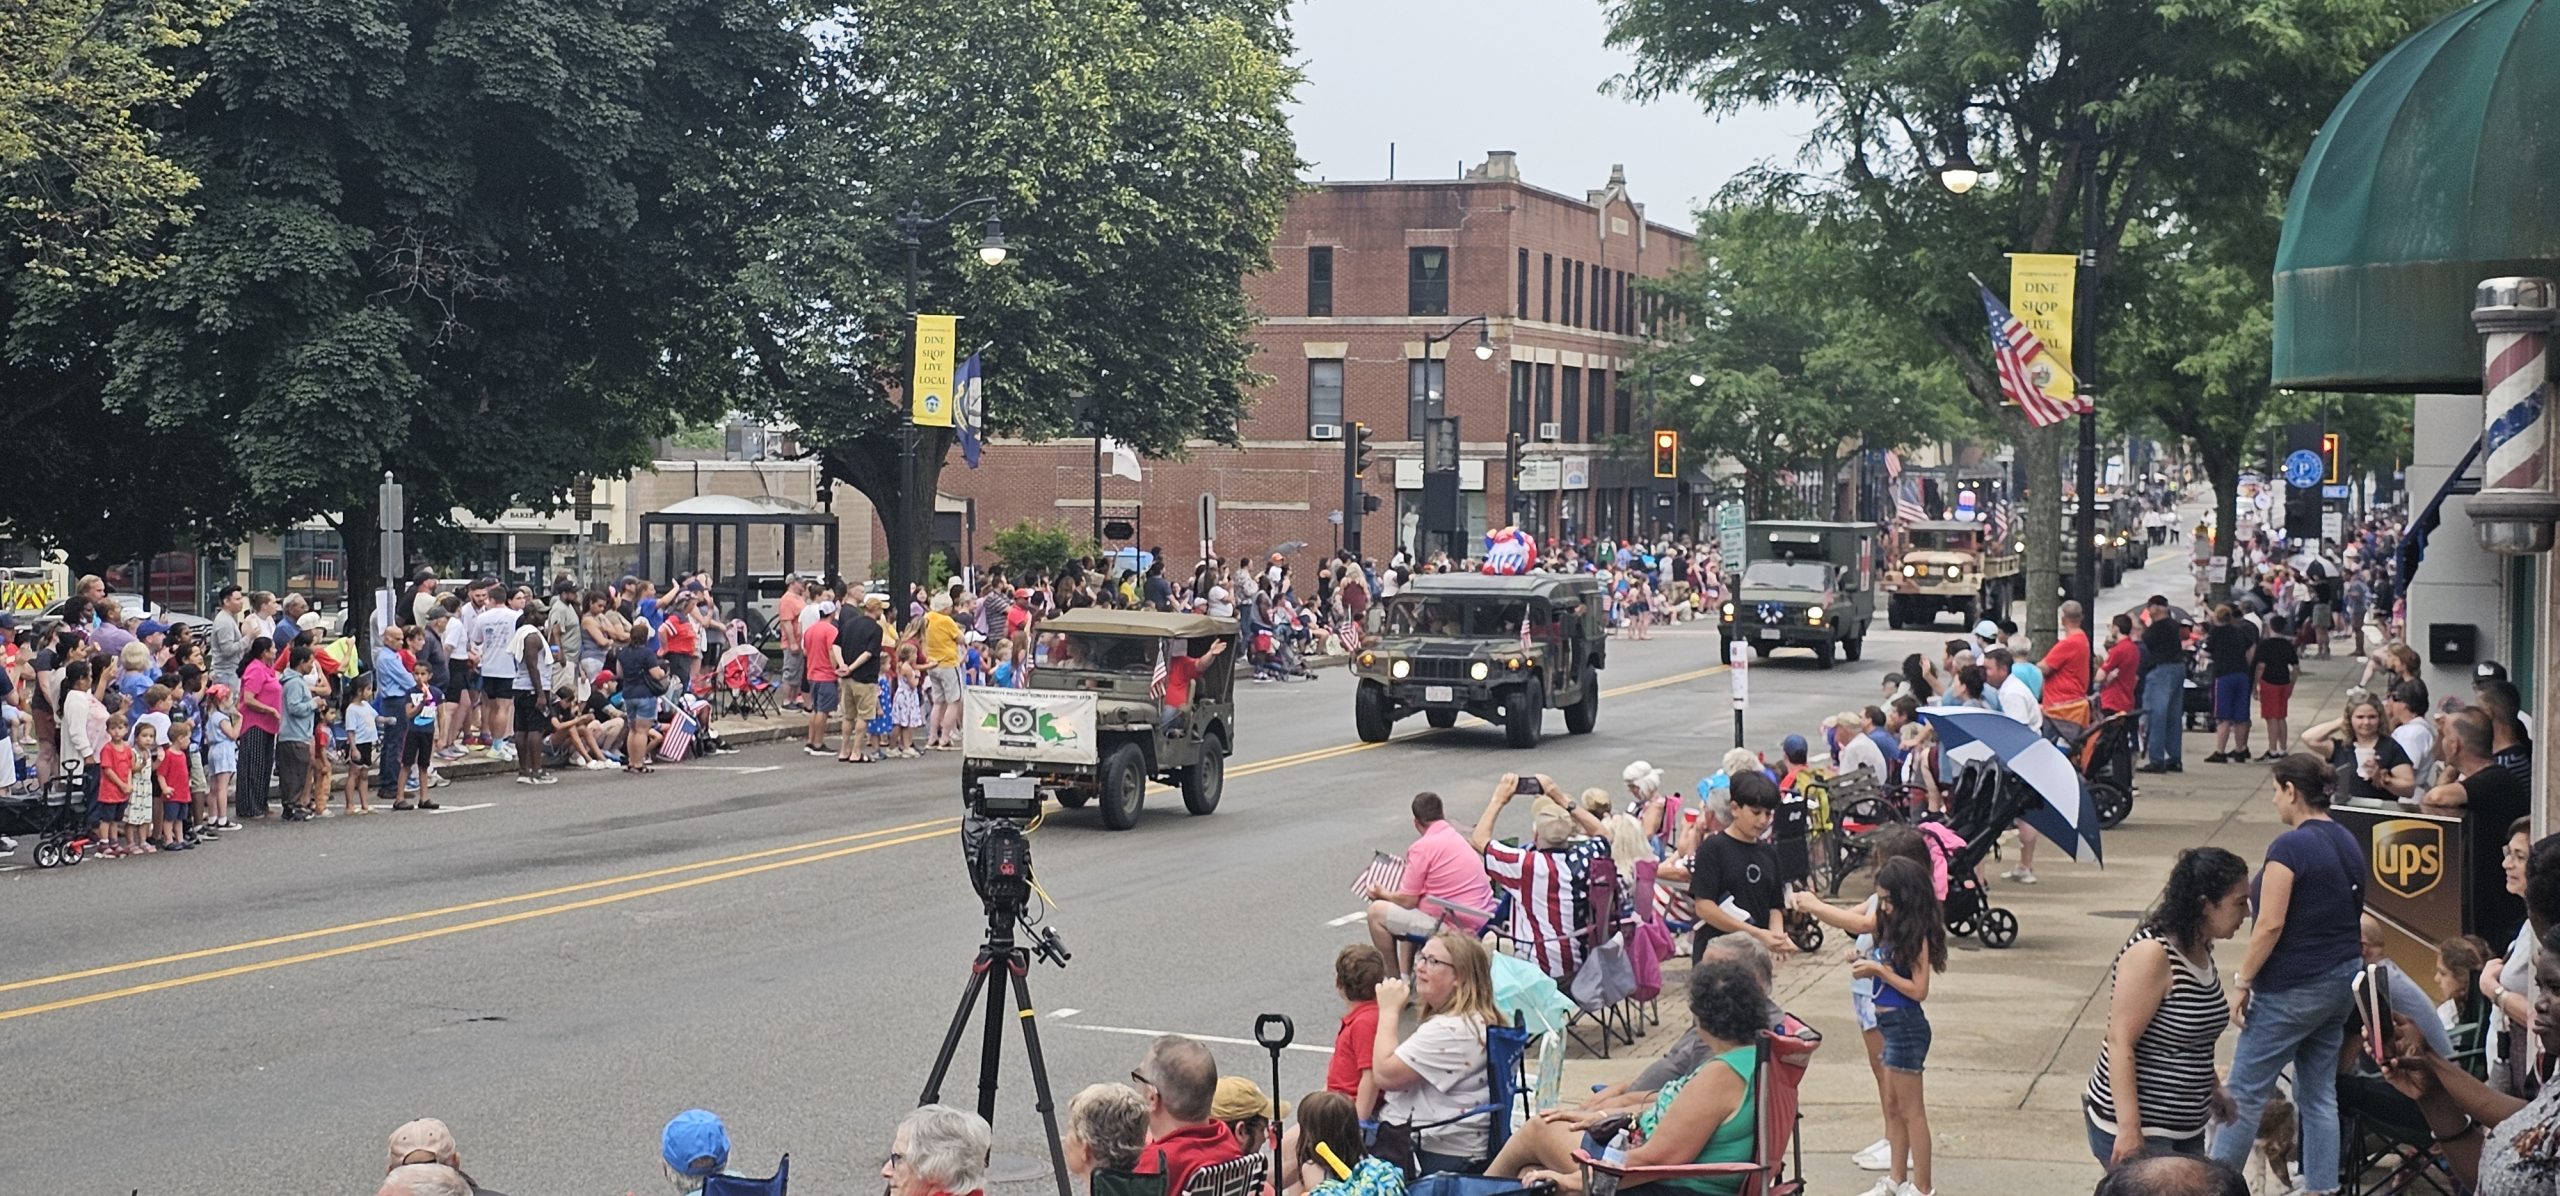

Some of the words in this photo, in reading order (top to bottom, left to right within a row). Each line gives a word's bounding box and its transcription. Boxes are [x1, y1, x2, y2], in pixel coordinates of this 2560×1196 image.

[2025, 282, 2058, 294] DINE
[2021, 301, 2058, 315] SHOP
[2026, 319, 2054, 331] LIVE
[924, 335, 946, 345] DINE
[922, 349, 946, 361] SHOP
[923, 362, 943, 371] LIVE
[919, 376, 947, 385] LOCAL
[2378, 843, 2439, 887] ups
